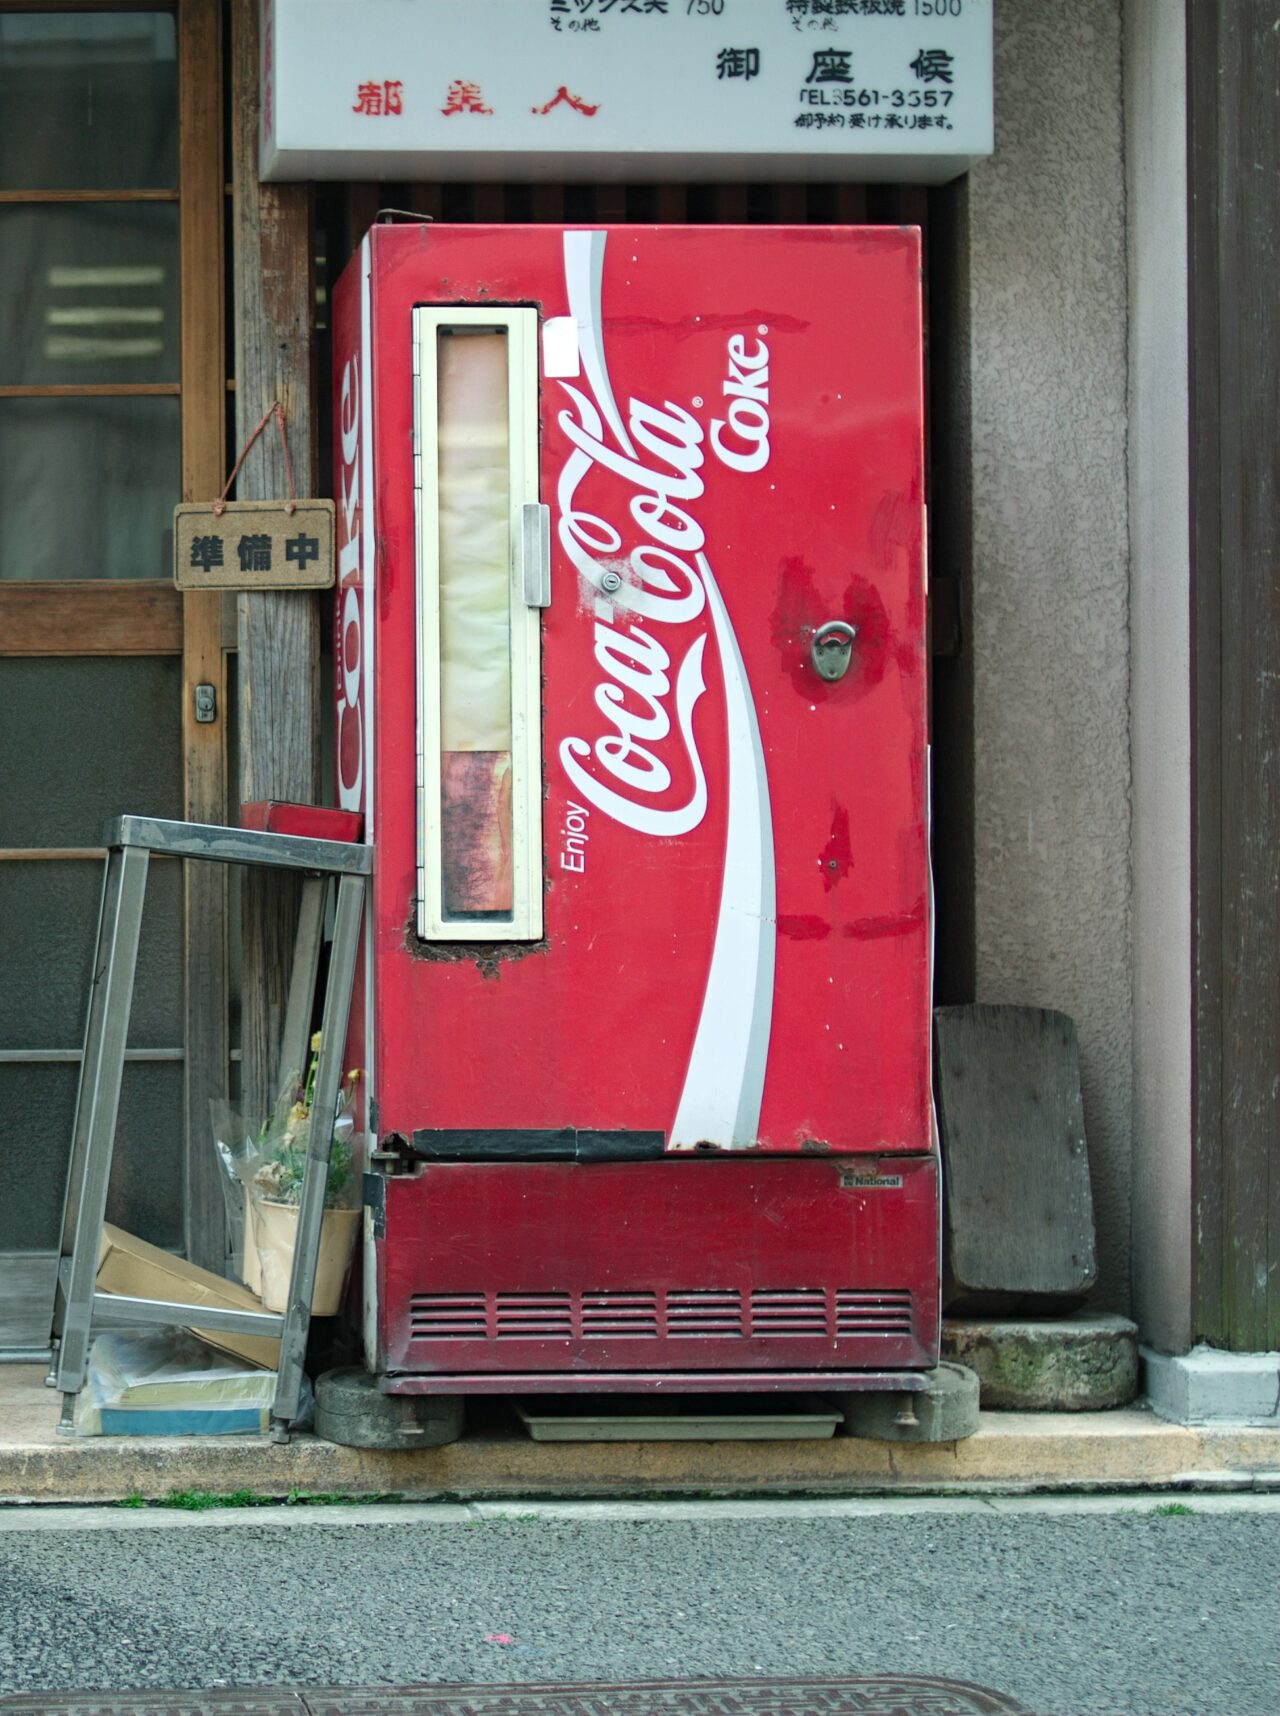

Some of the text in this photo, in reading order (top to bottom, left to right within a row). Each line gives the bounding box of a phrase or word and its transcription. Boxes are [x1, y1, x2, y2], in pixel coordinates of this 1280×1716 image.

[550, 16, 601, 32] その他
[709, 333, 770, 473] Coke
[190, 532, 320, 573] 準備中
[336, 354, 363, 813] Coke
[557, 380, 708, 837] Coca-Cola
[560, 800, 590, 873] Enjoy
[855, 1175, 900, 1186] National
